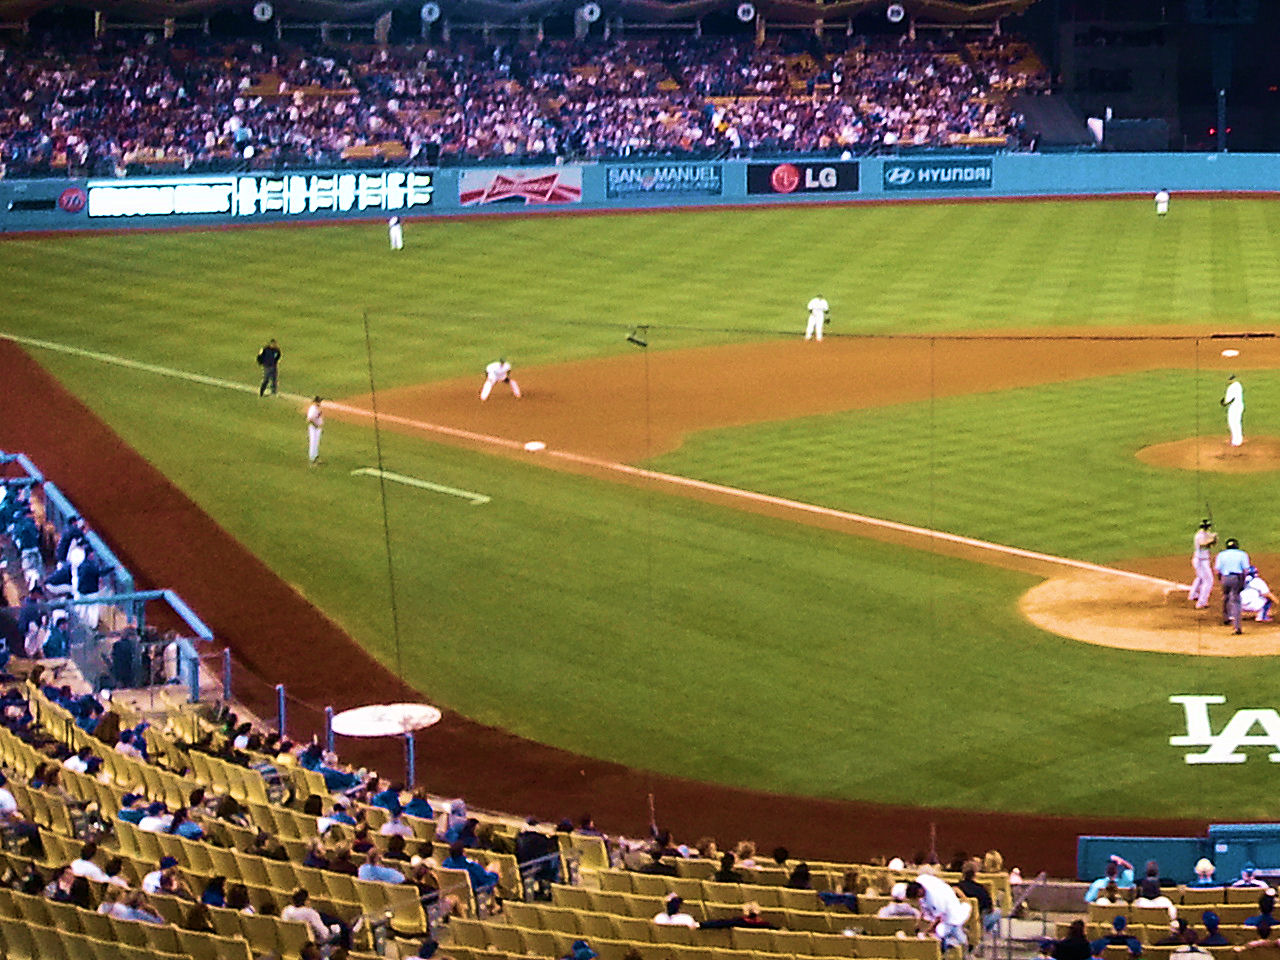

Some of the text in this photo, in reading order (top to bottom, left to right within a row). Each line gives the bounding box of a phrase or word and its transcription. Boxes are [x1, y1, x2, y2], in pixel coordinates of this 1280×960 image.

[654, 166, 719, 181] MANUEL
[805, 167, 837, 188] LG
[918, 167, 991, 181] HYUNDAI
